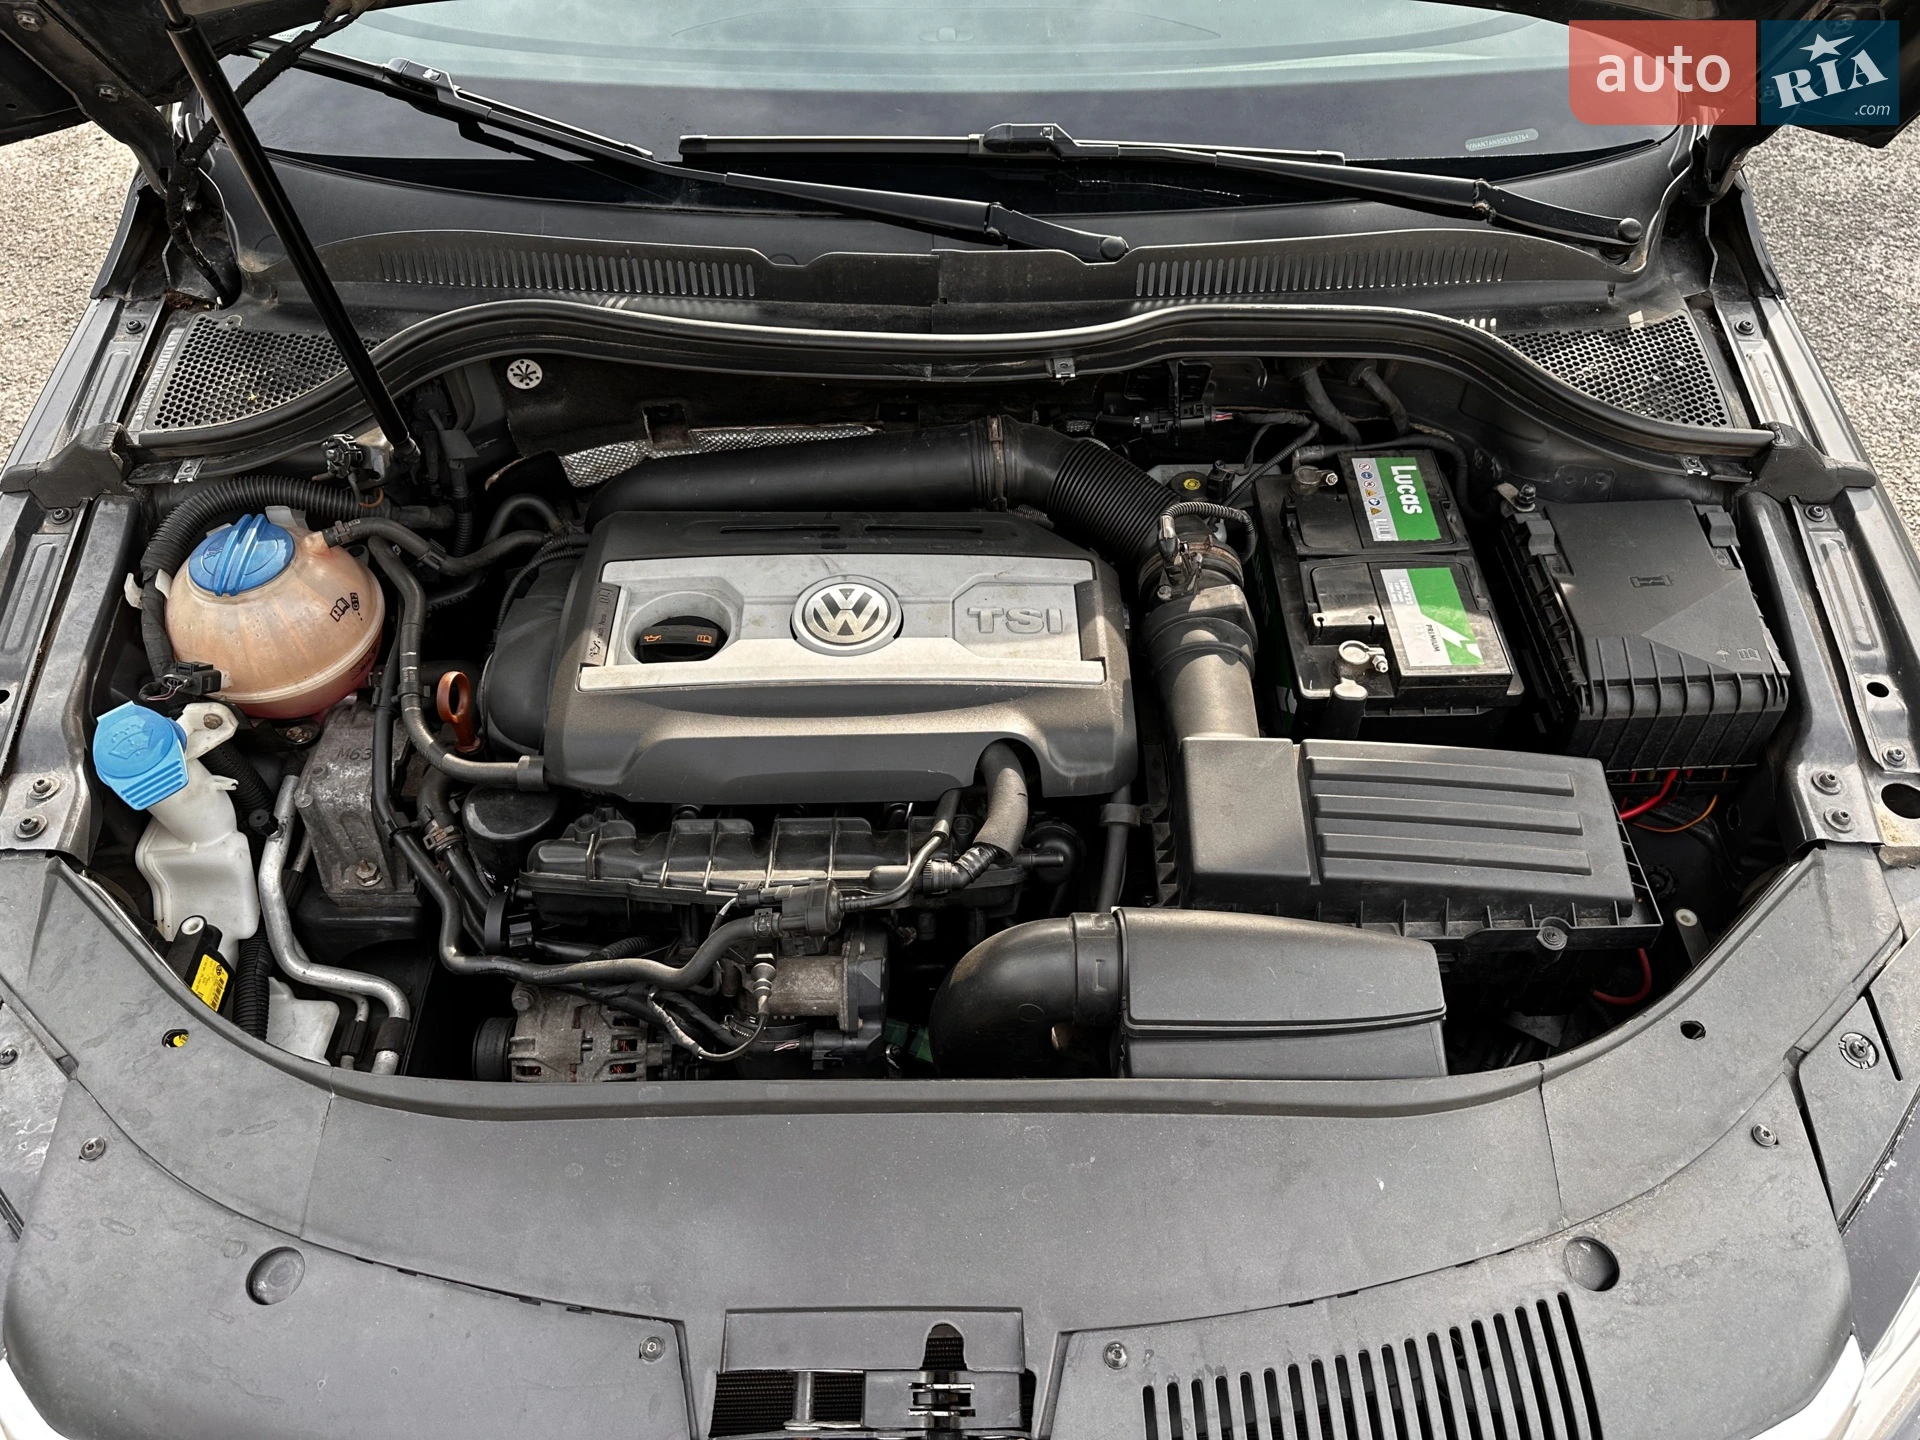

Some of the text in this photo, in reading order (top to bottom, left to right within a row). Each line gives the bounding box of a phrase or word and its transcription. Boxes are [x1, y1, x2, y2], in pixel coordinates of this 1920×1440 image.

[806, 584, 888, 643] VW
[967, 607, 1063, 634] TSI
[1426, 624, 1440, 652] PREMIUM
